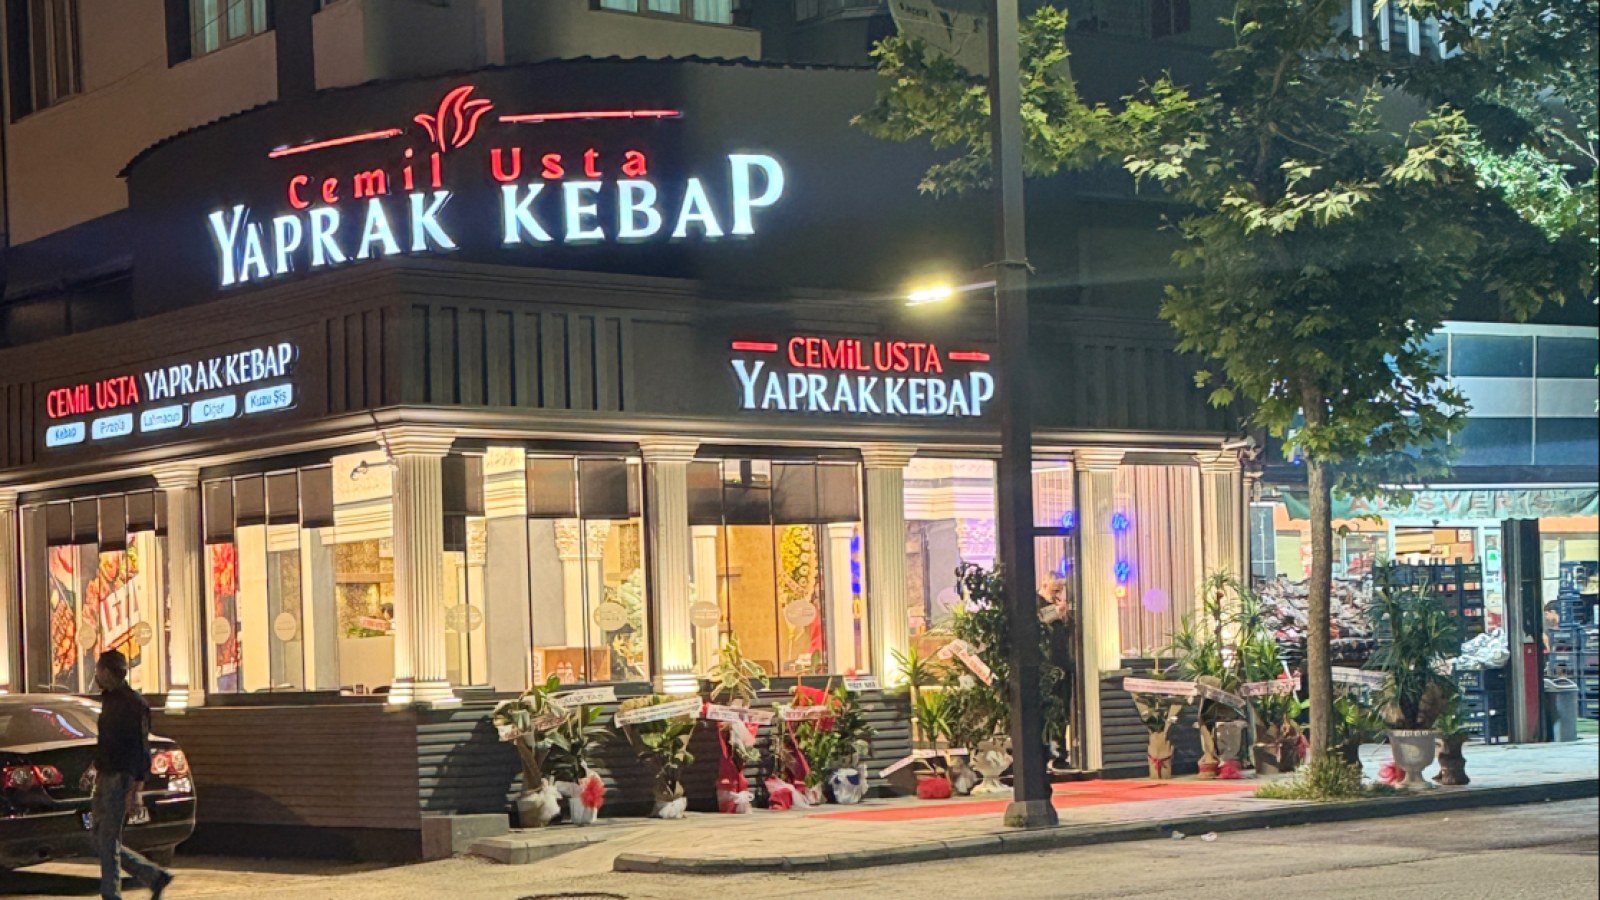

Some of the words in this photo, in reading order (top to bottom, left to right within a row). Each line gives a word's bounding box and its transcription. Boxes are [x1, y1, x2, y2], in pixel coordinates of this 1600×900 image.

[287, 148, 444, 209] Cemil
[489, 146, 649, 182] Usta
[207, 190, 458, 288] YAPRAK
[501, 153, 786, 244] KEBAP
[96, 375, 139, 410] USTA
[144, 357, 223, 401] YAPRAK
[224, 342, 294, 386] KEBAP
[731, 359, 882, 414] YAPRAK
[885, 371, 995, 416] KEBAP
[874, 341, 944, 374] USTA
